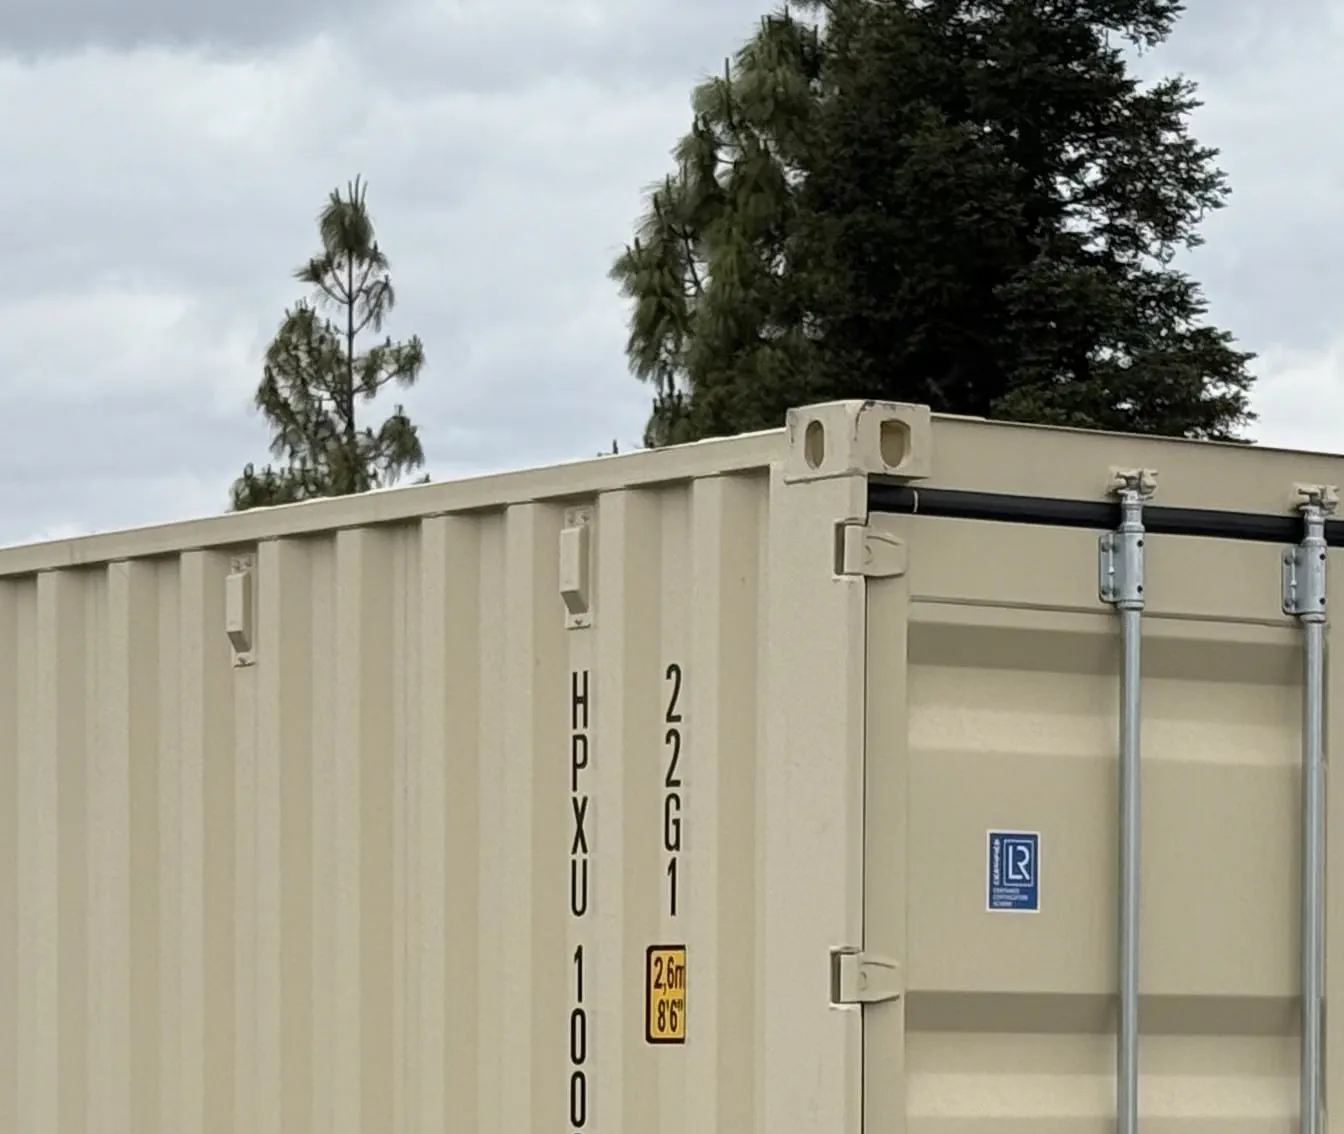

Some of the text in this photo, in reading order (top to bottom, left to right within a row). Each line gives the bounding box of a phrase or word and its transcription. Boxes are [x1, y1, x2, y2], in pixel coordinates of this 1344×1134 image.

[571, 670, 588, 917] HPXU
[665, 663, 682, 917] 22G1
[1008, 845, 1031, 880] LR
